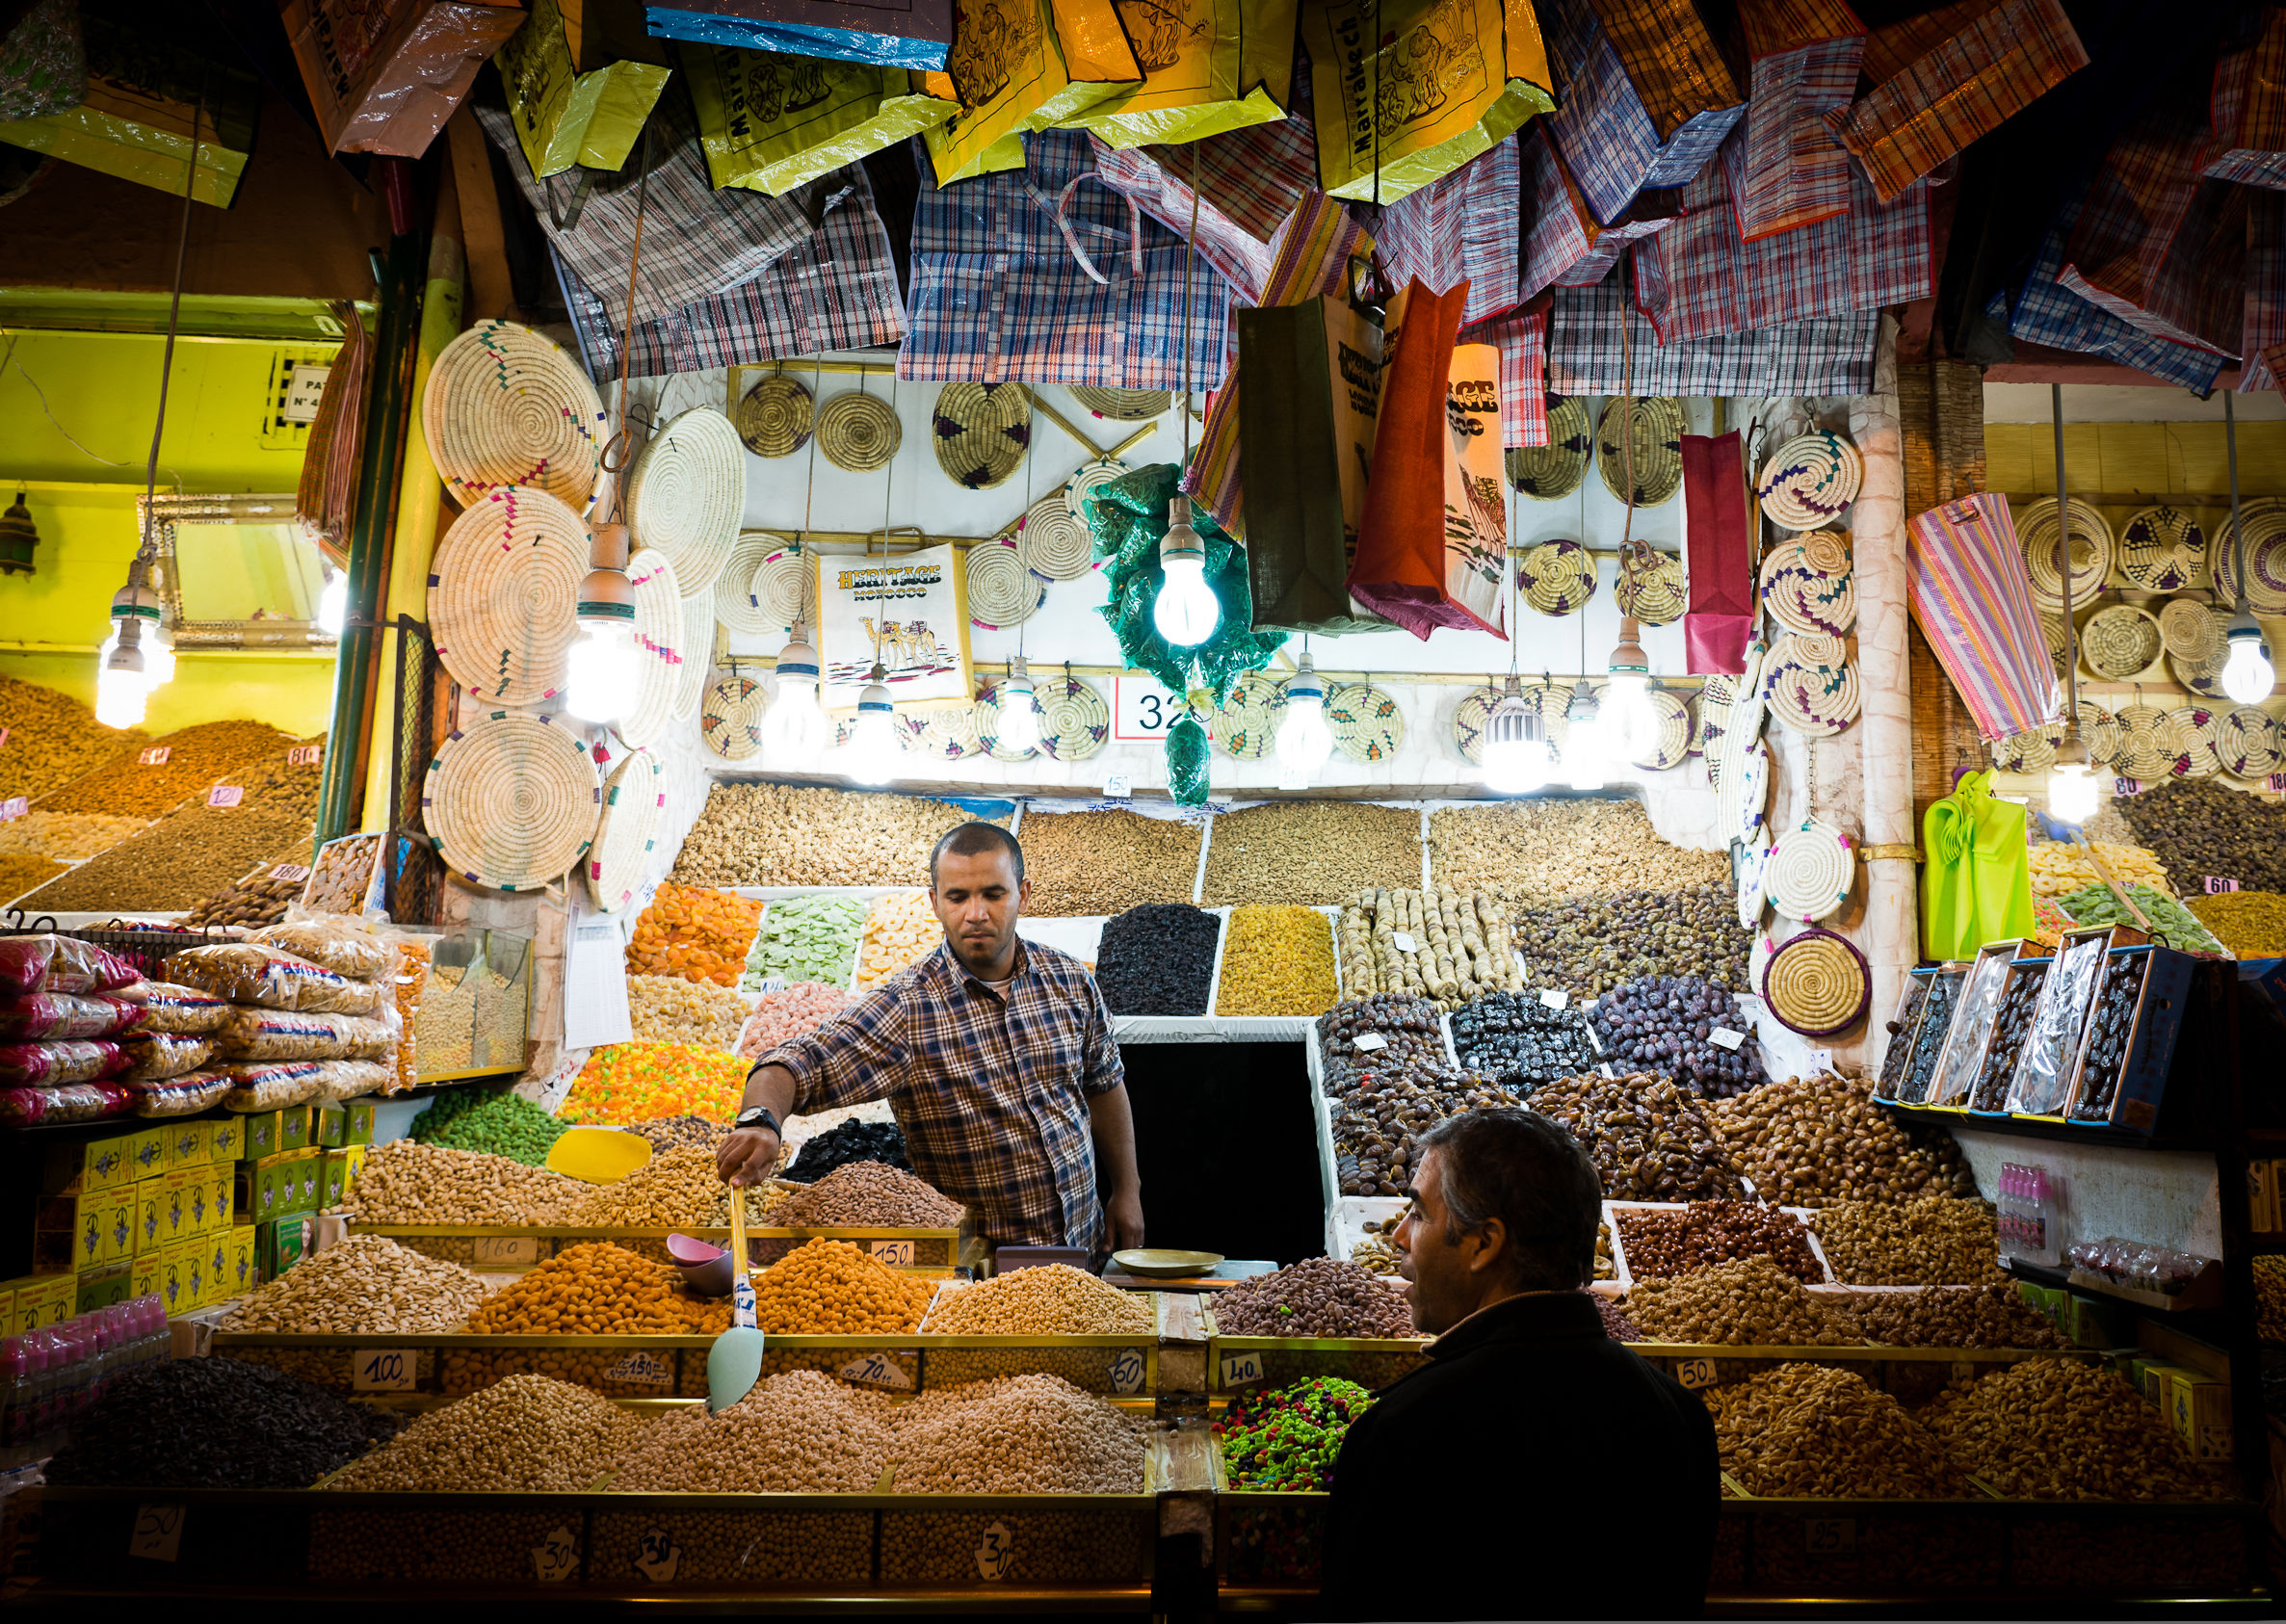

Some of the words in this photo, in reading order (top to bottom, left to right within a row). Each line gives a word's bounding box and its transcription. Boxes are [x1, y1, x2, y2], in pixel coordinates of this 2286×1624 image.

[1335, 15, 1373, 155] Marrakech
[838, 564, 941, 589] HERITAGE
[854, 588, 927, 602] MOROCCO
[2115, 777, 2138, 796] 80
[2211, 877, 2231, 894] 60
[484, 1238, 518, 1258] 160
[875, 1244, 907, 1265] 150
[364, 1352, 404, 1383] 100
[629, 1359, 653, 1376] 150
[860, 1359, 885, 1379] 70
[1115, 1356, 1140, 1384] 60
[1229, 1359, 1254, 1380] 40
[1683, 1361, 1708, 1385] 50
[542, 1541, 569, 1569] 30
[644, 1535, 670, 1565] 30
[985, 1533, 1008, 1574] 30
